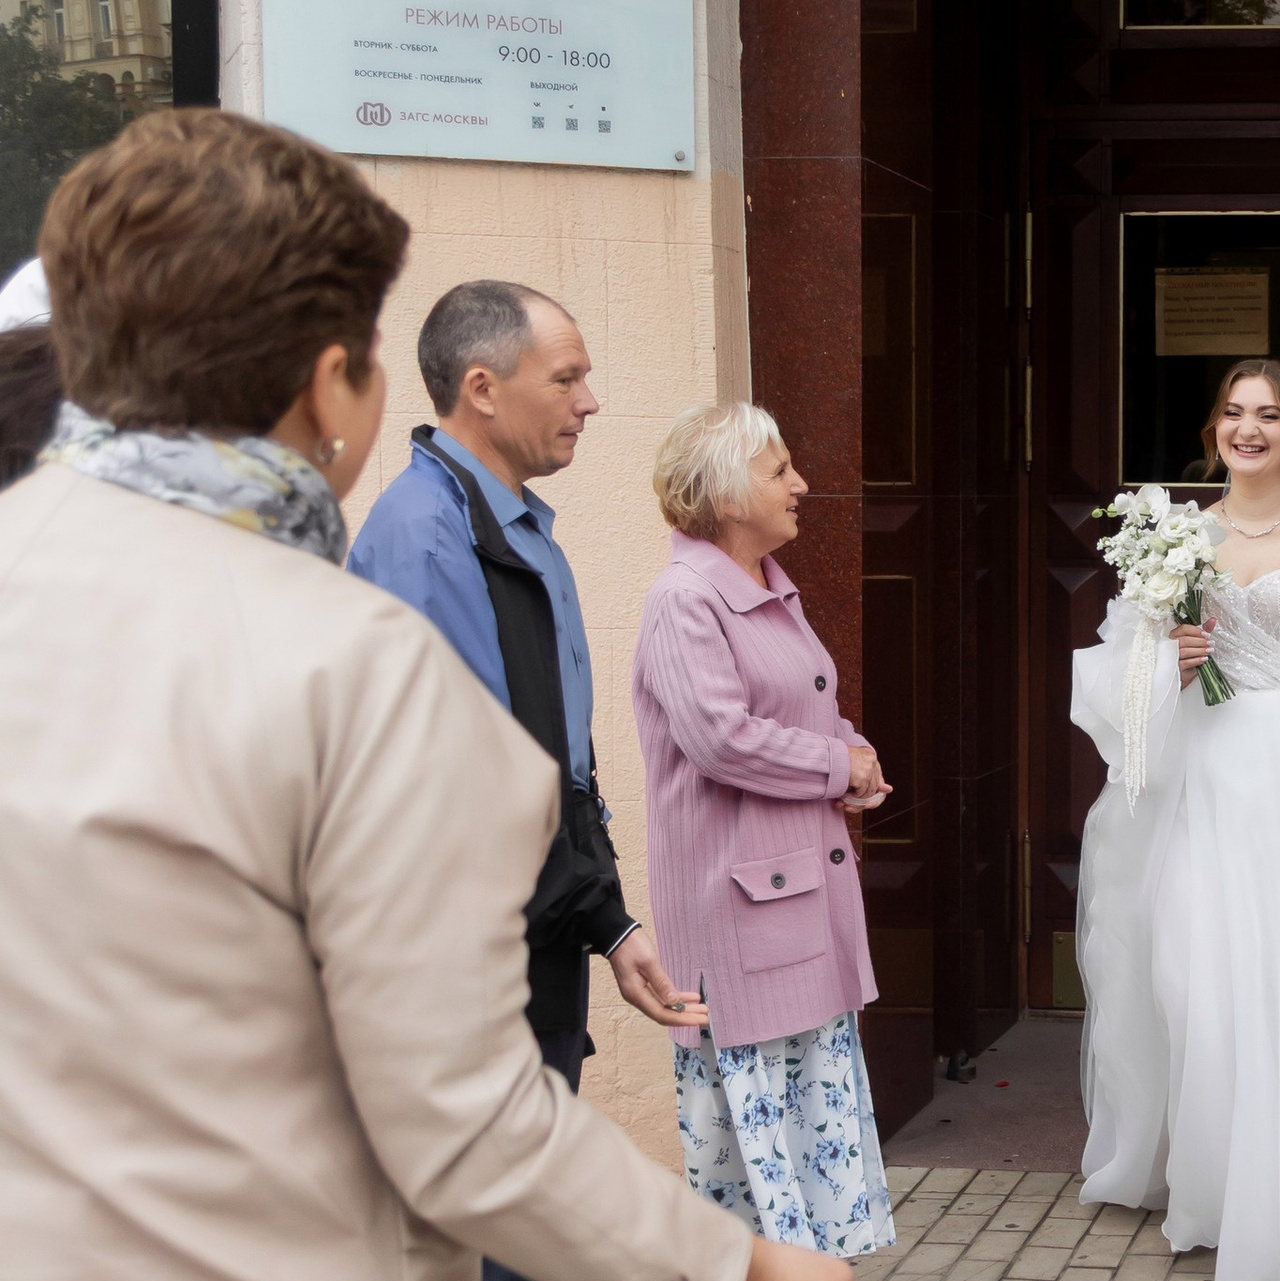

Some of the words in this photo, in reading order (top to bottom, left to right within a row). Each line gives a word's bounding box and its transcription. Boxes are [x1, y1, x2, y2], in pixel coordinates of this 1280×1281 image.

[405, 8, 480, 29] РЕЖИМ
[487, 14, 562, 35] РАБОТЫ
[354, 40, 393, 50] ВТОРНИК
[400, 43, 438, 53] СУББОТА
[499, 45, 541, 64] 9:00
[563, 50, 611, 69] 18:00
[354, 69, 413, 80] ВОСКРЕСЕНЬЕ
[420, 73, 483, 85] ПОНЕДЕЛЬНИК
[530, 81, 578, 92] ВЫХОДНОЙ
[399, 111, 430, 122] ЗАГС
[432, 113, 488, 125] МОСКВЫ
